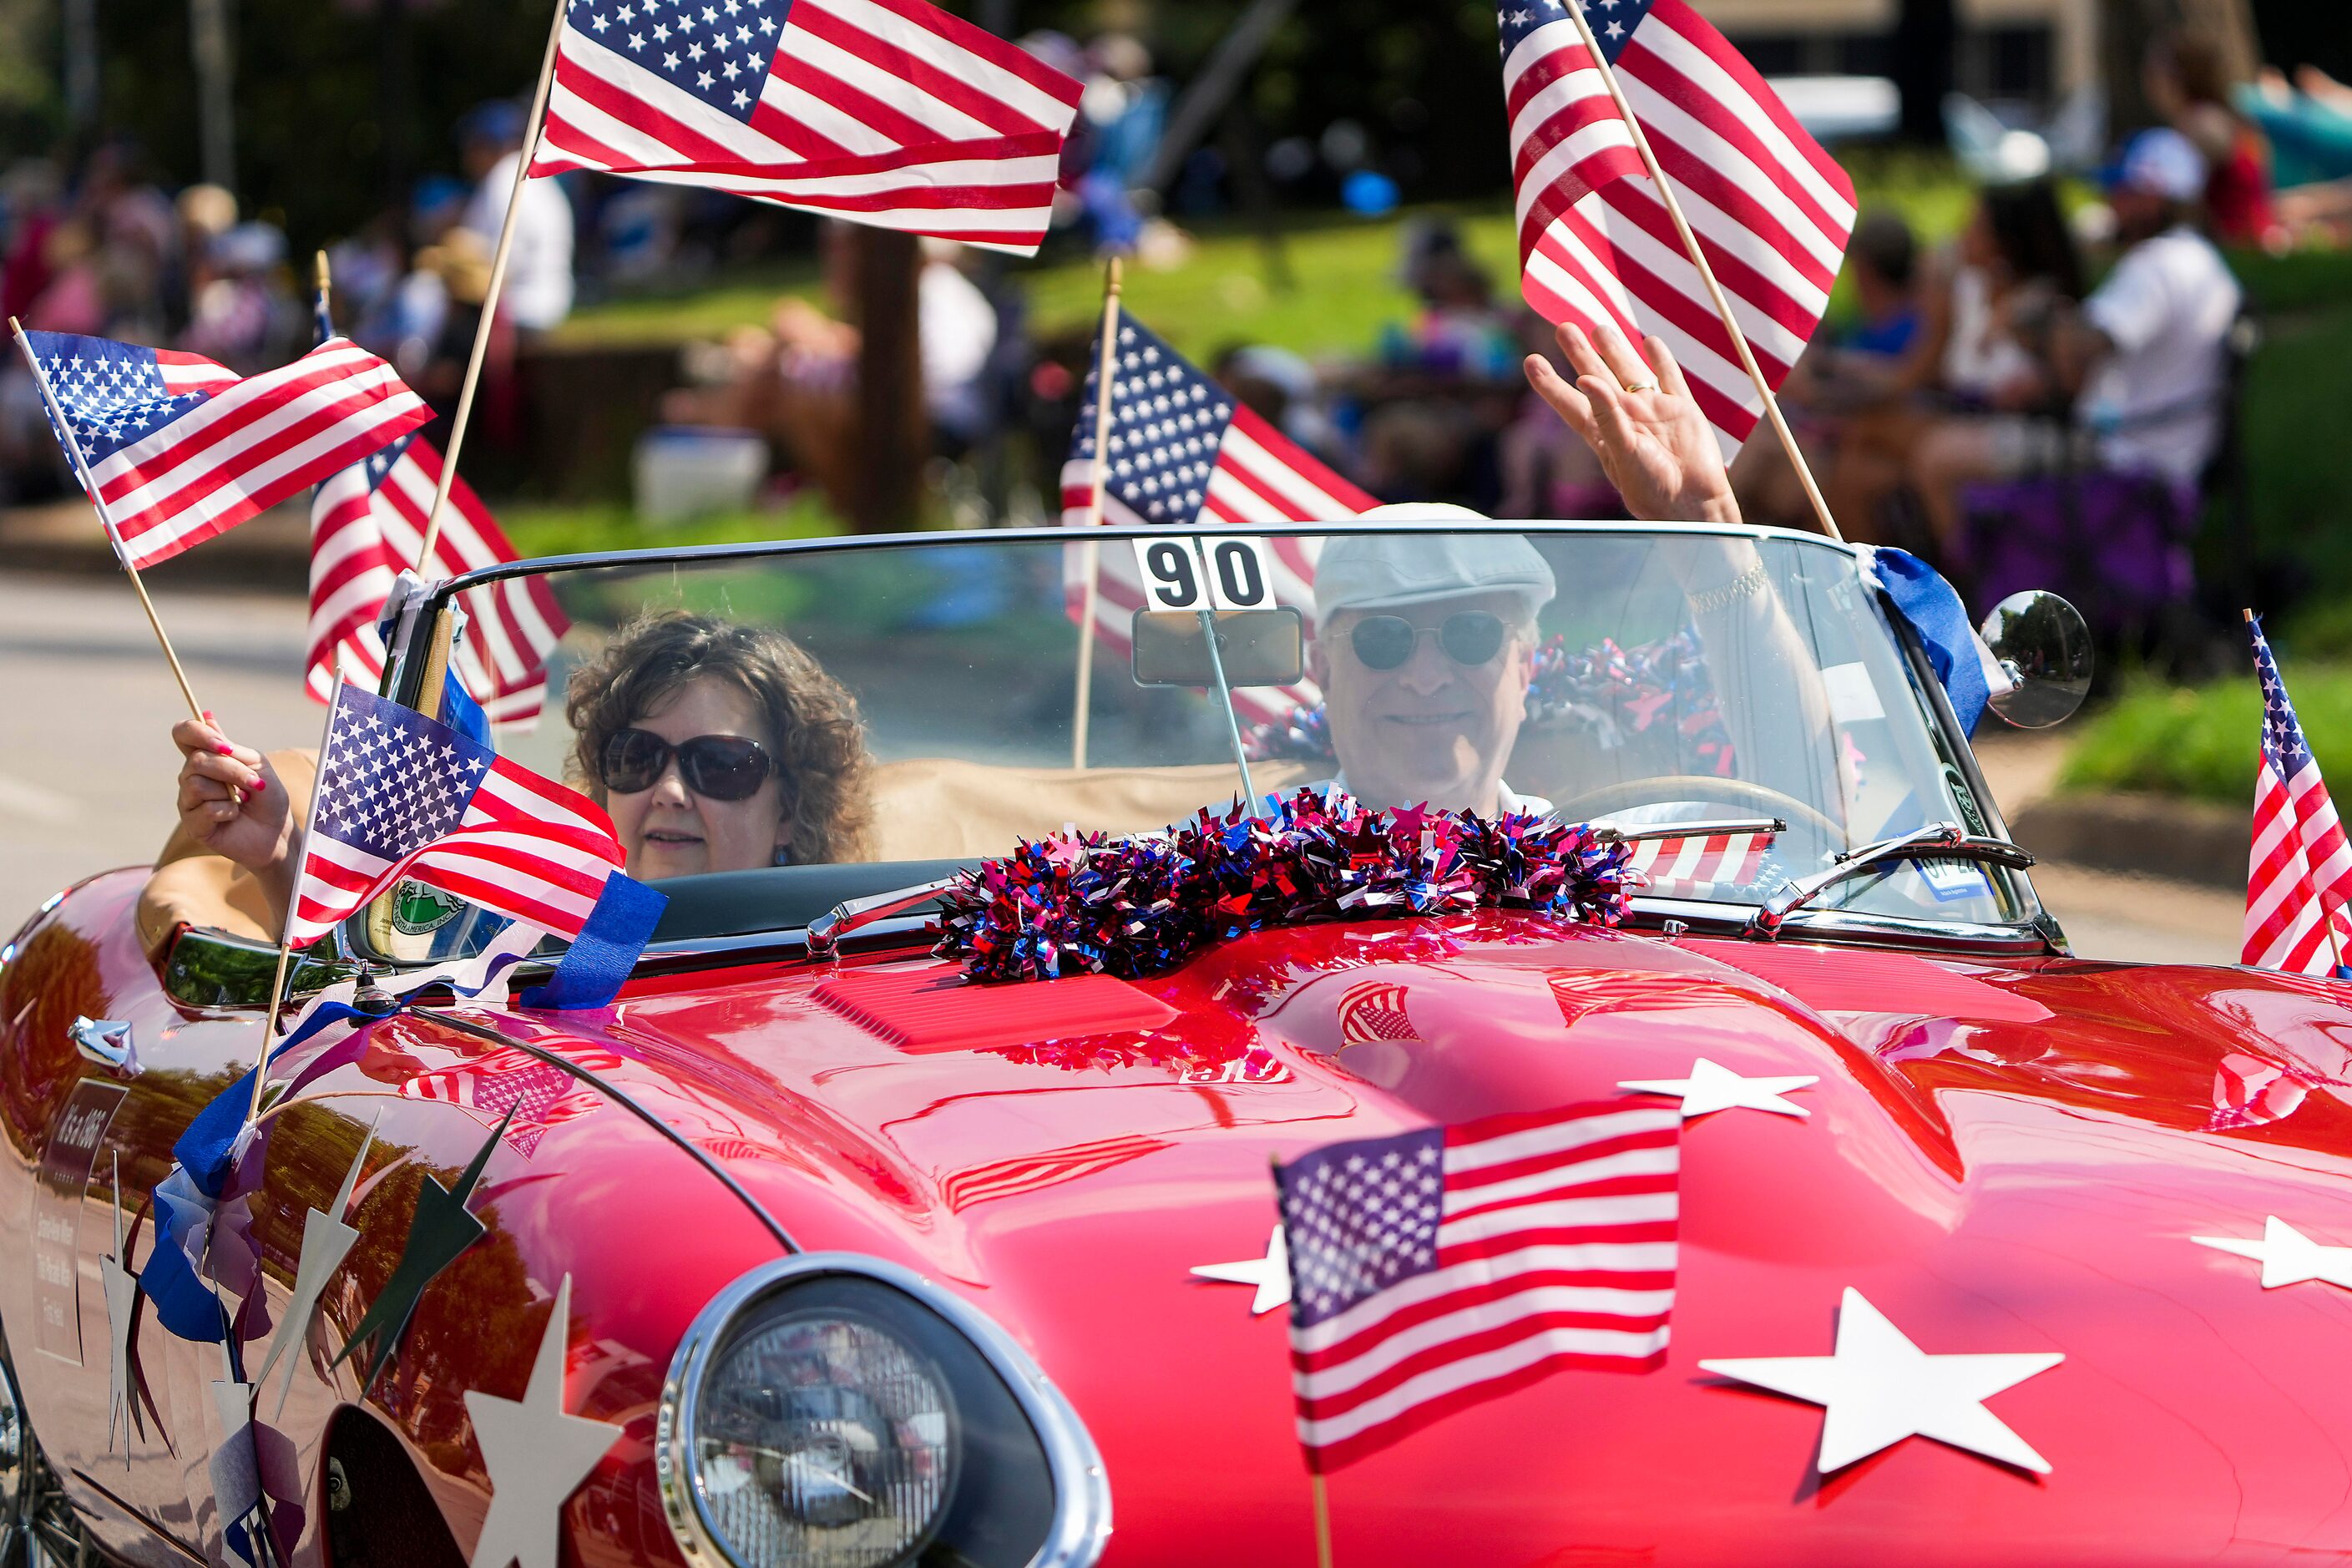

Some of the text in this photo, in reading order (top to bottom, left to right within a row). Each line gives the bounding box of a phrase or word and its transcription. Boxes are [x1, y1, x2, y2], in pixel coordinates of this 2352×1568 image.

[1147, 540, 1265, 607] 90
[394, 912, 407, 930] NORTH
[437, 913, 453, 925] INC.
[69, 1115, 83, 1145] a
[76, 1108, 107, 1149] 1966
